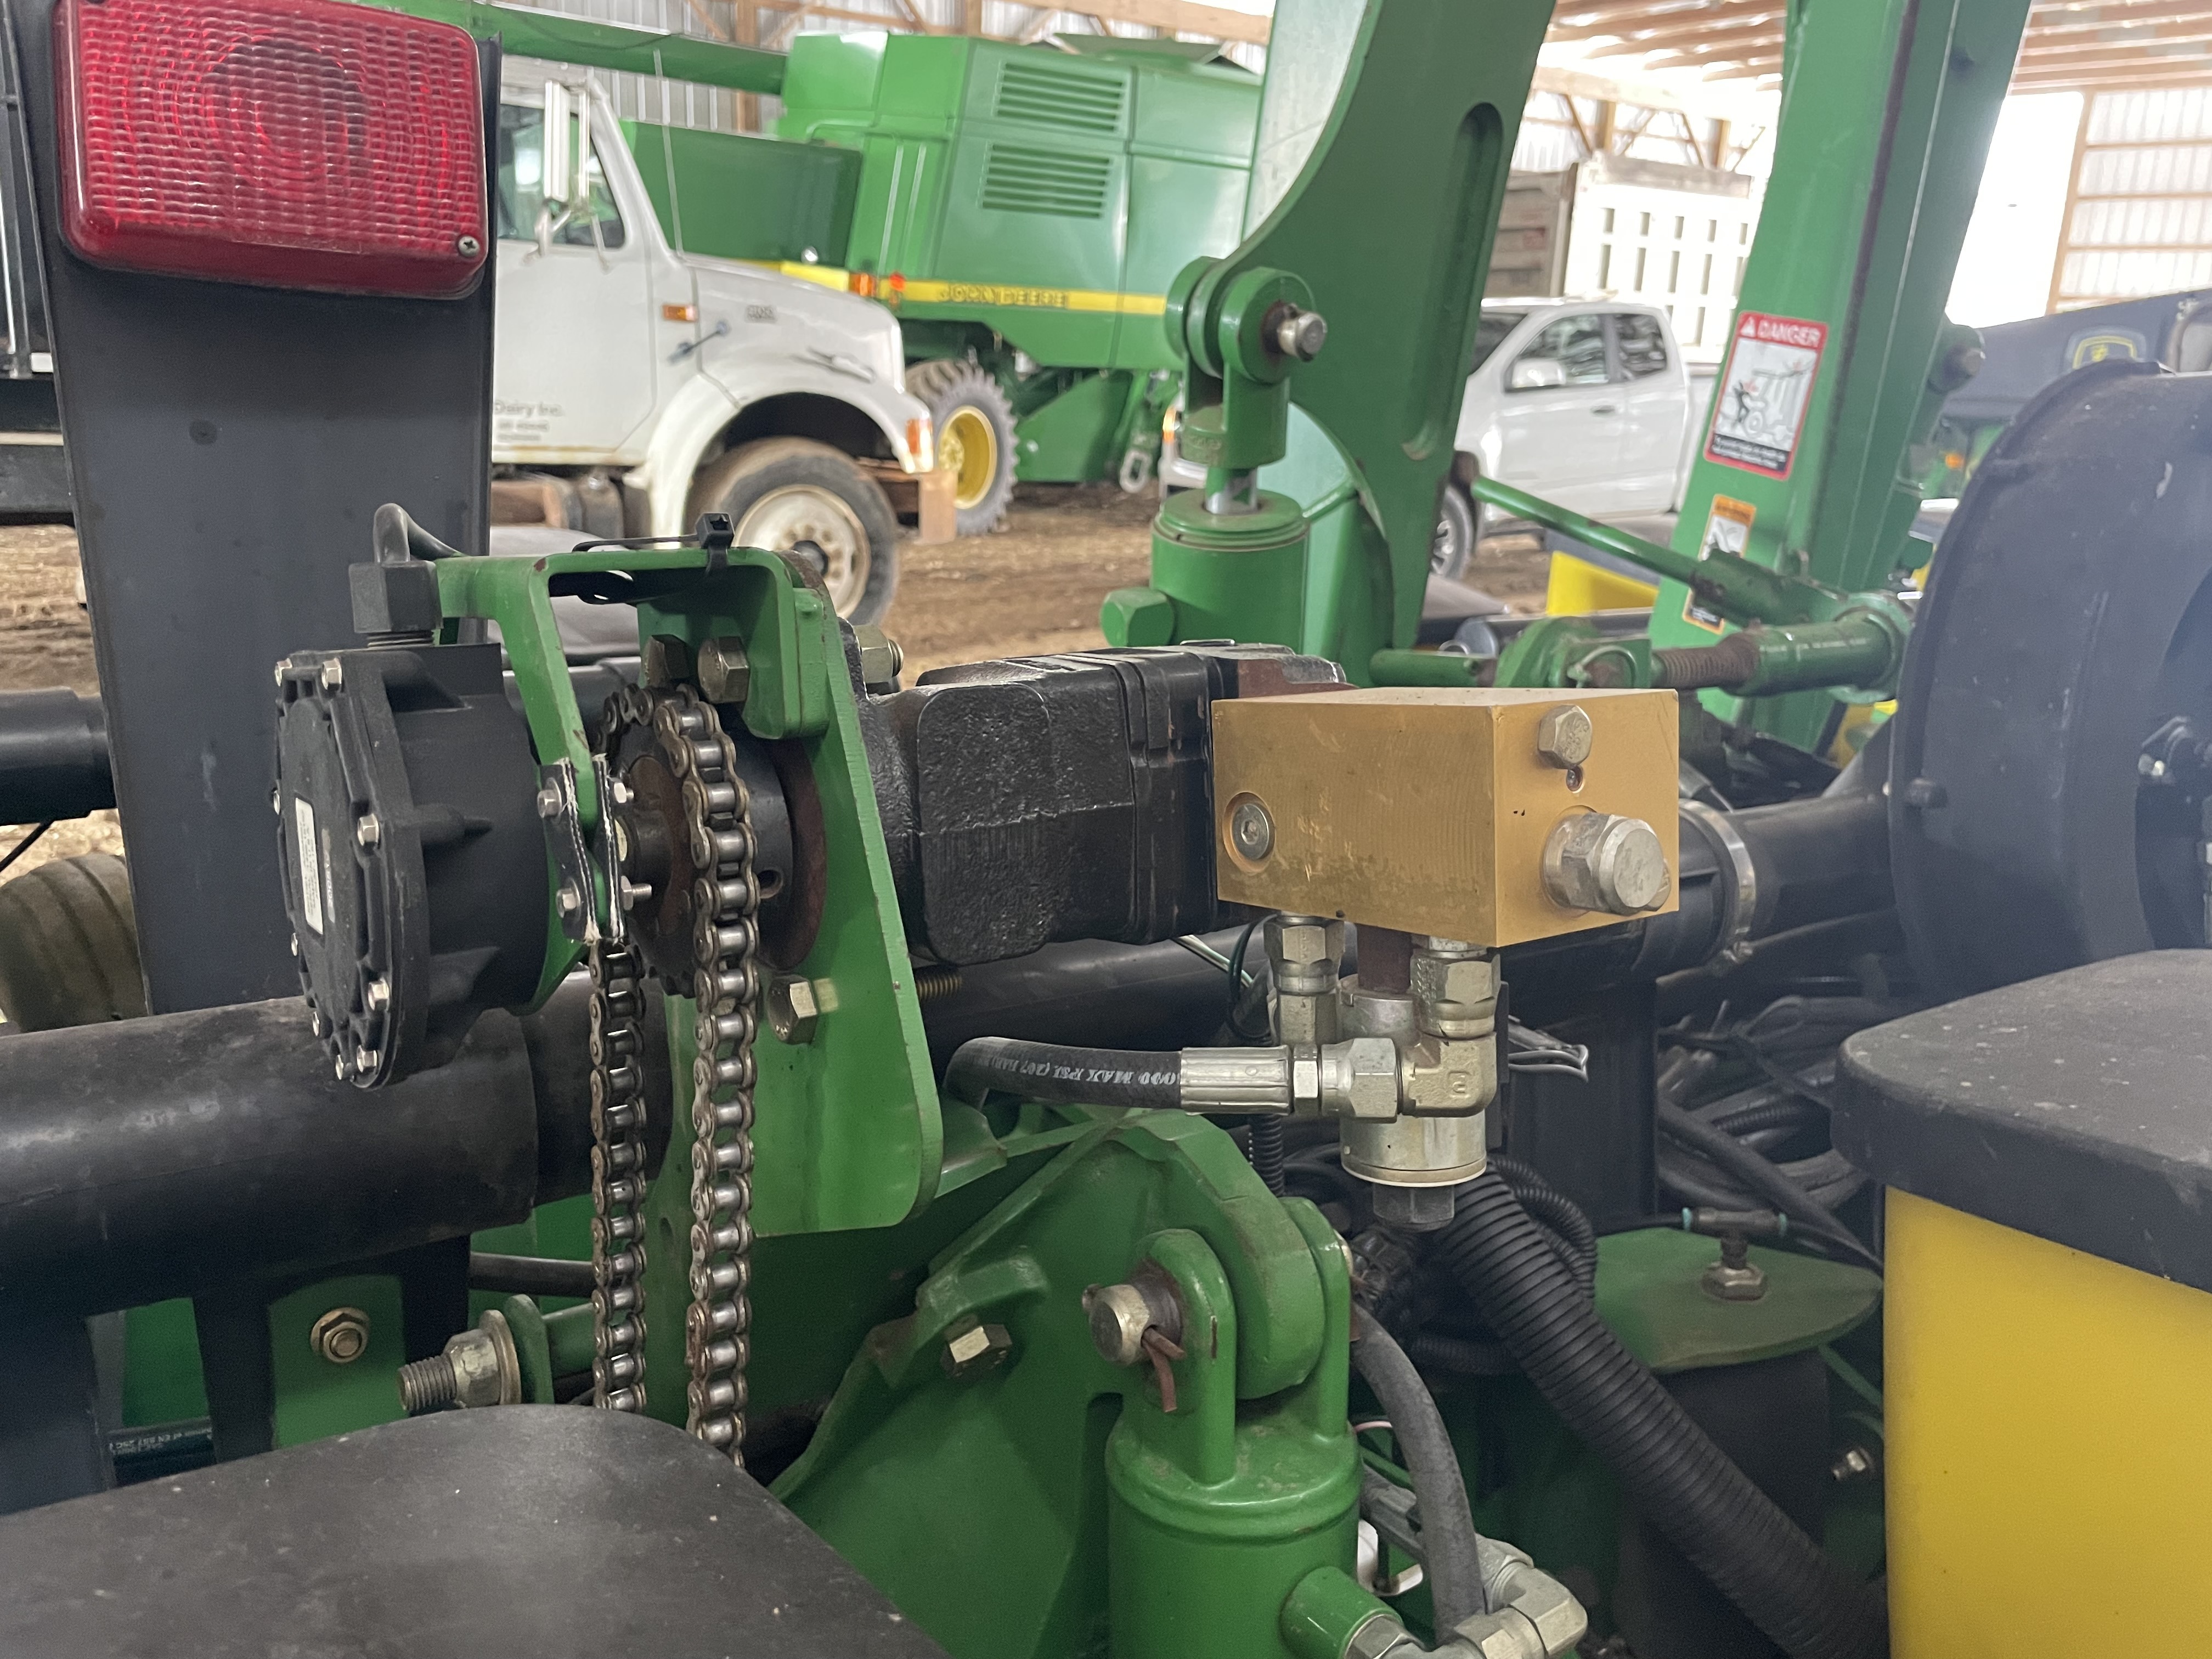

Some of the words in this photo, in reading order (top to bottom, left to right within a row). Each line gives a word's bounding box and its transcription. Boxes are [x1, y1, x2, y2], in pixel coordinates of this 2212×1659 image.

[939, 283, 996, 304] JOHN
[997, 288, 1068, 308] DEERE
[1757, 318, 1821, 348] DANGER
[1086, 1069, 1135, 1084] MAX
[1137, 1071, 1180, 1085] 000
